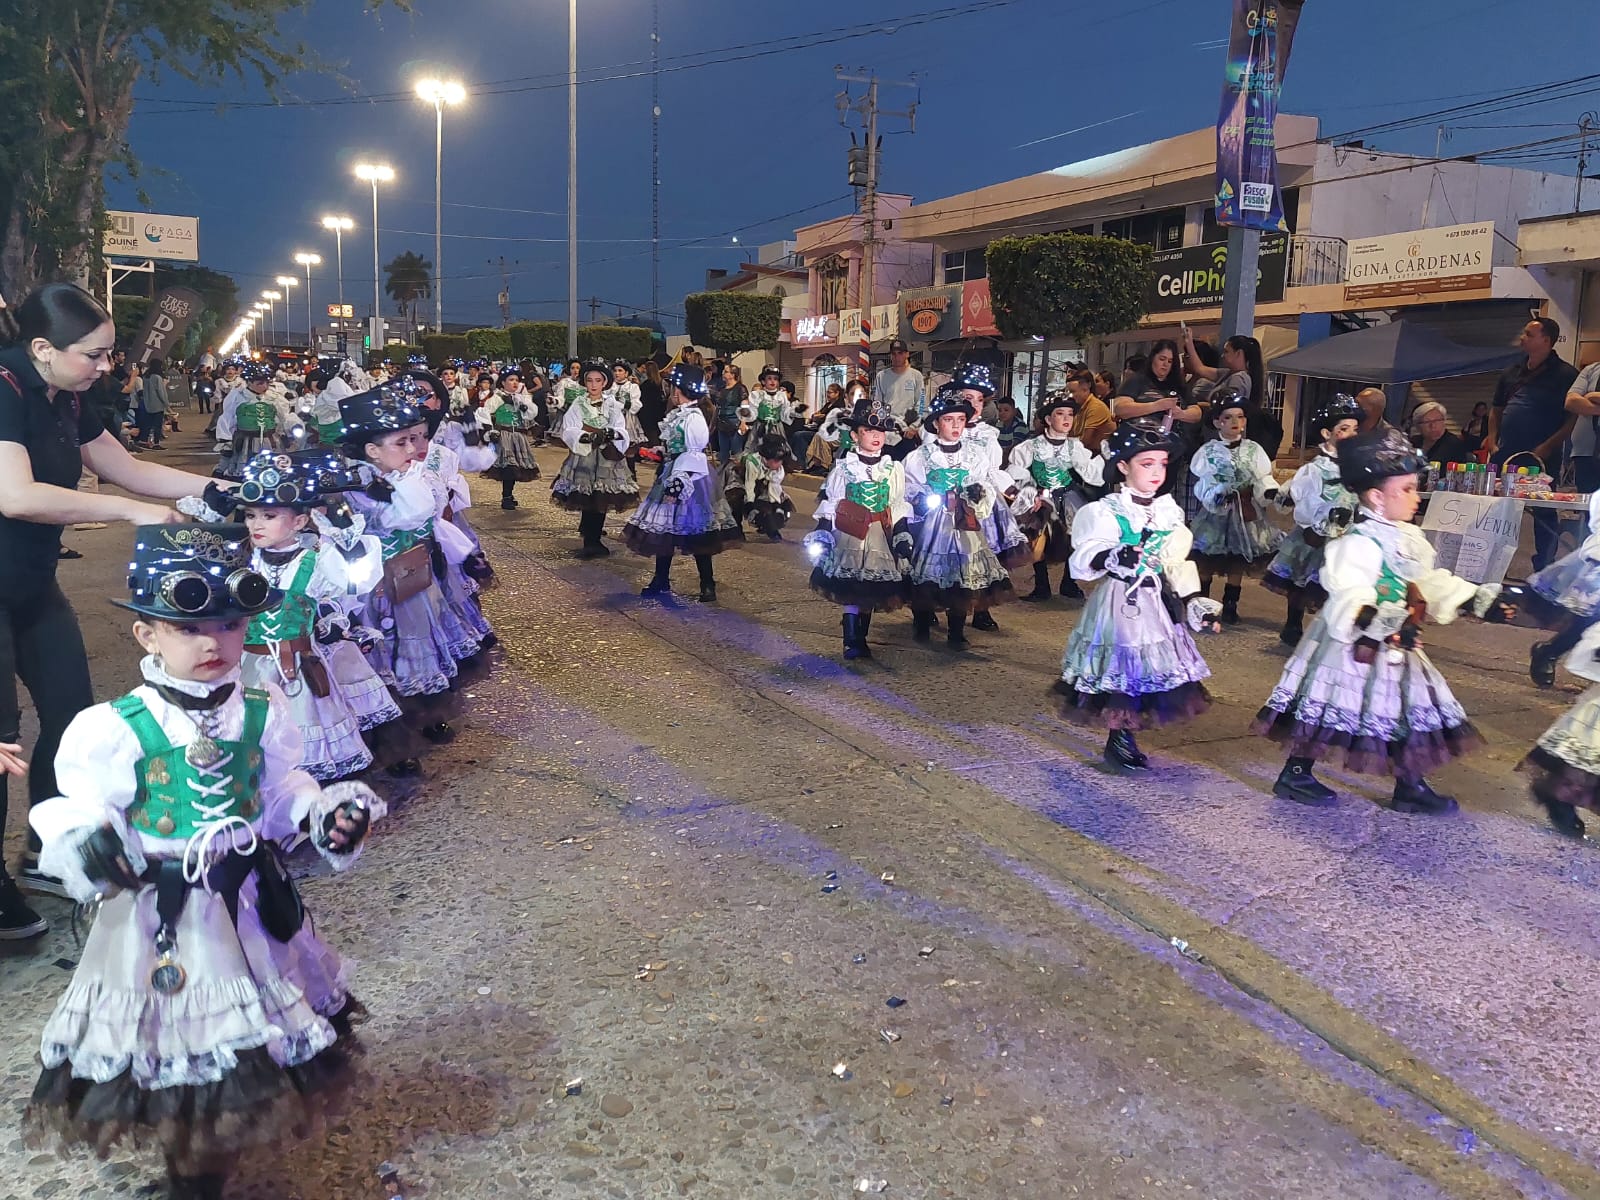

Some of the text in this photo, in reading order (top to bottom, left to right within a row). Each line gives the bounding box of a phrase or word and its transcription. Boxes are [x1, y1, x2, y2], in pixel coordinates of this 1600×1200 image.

[151, 226, 192, 237] PRAGA
[1353, 262, 1389, 277] GINA
[1395, 251, 1481, 273] CARDENAS
[160, 300, 188, 318] COPAS
[167, 294, 189, 311] TRES
[917, 316, 932, 328] 1907
